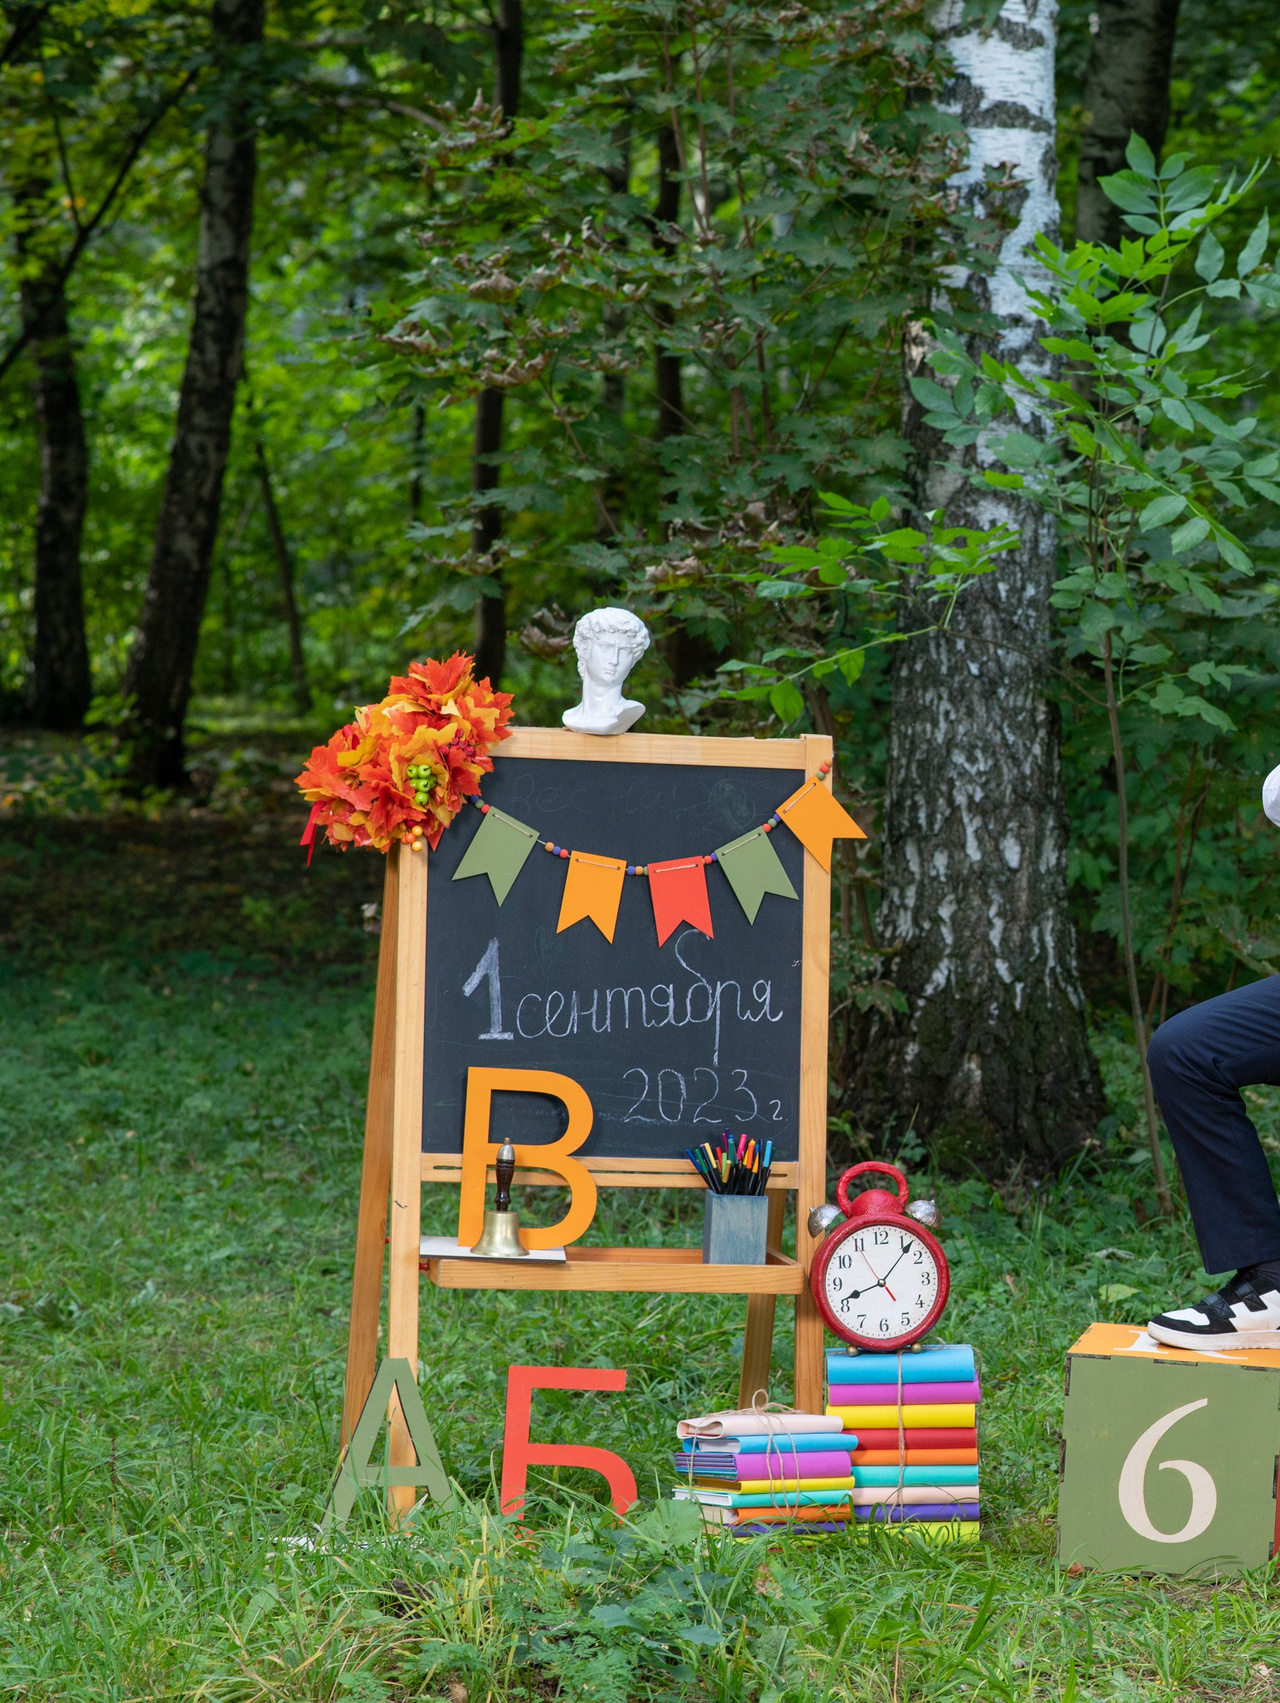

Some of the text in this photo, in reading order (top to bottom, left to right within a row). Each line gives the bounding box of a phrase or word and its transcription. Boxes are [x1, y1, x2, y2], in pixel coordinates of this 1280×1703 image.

[462, 936, 514, 1041] 1
[458, 1066, 598, 1250] В
[853, 1238, 866, 1252] 11
[873, 1230, 889, 1245] 12
[837, 1254, 852, 1269] 10
[913, 1250, 923, 1264] 2
[832, 1277, 843, 1291] 9
[921, 1271, 931, 1286] 3
[840, 1299, 850, 1313] 8
[915, 1294, 925, 1308] 4
[857, 1314, 867, 1329] 7
[879, 1317, 889, 1332] 6
[901, 1311, 910, 1326] 5
[1118, 1397, 1218, 1544] 6
